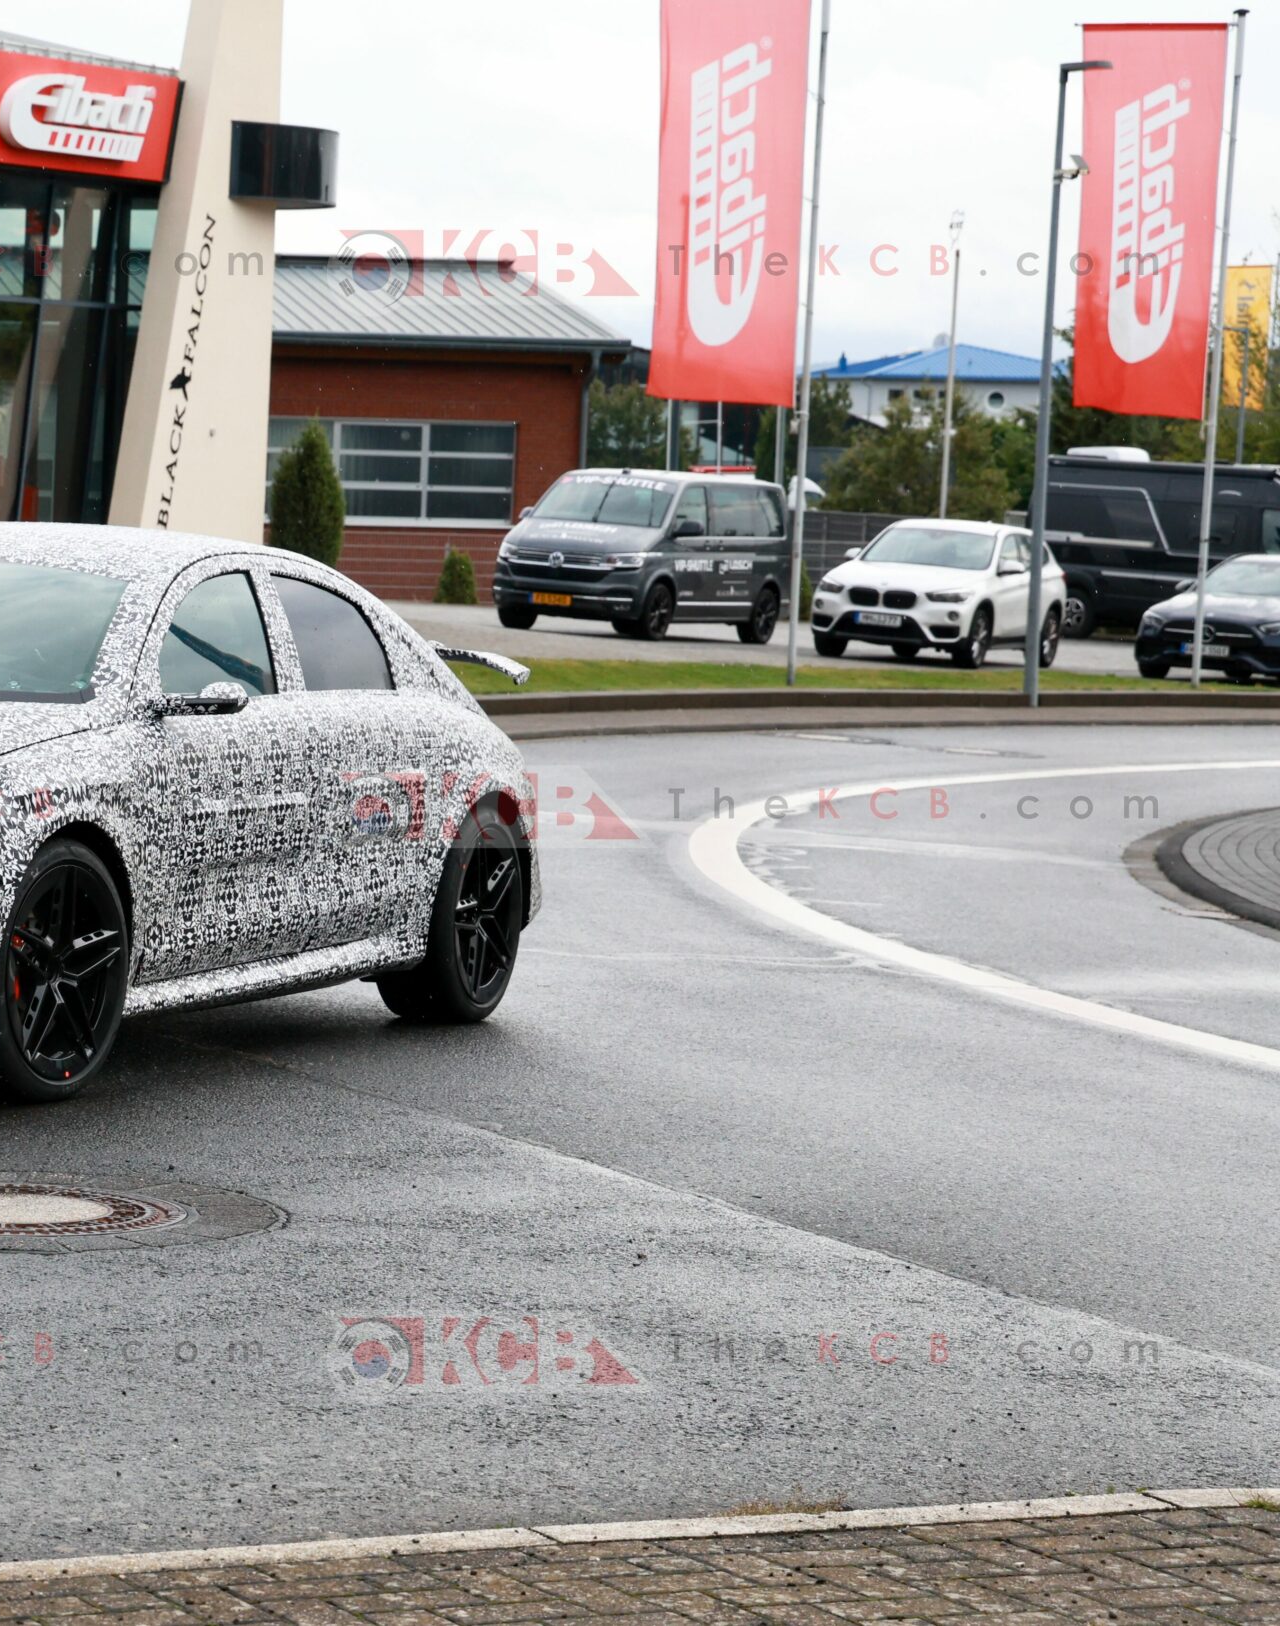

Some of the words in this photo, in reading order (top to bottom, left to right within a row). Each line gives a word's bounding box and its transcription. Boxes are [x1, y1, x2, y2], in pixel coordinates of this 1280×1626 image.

[157, 404, 187, 530] BLACK
[183, 213, 217, 364] FALCON
[575, 475, 668, 492] VIP-SHUTTLE
[674, 559, 714, 572] VIP-SHUTTLE
